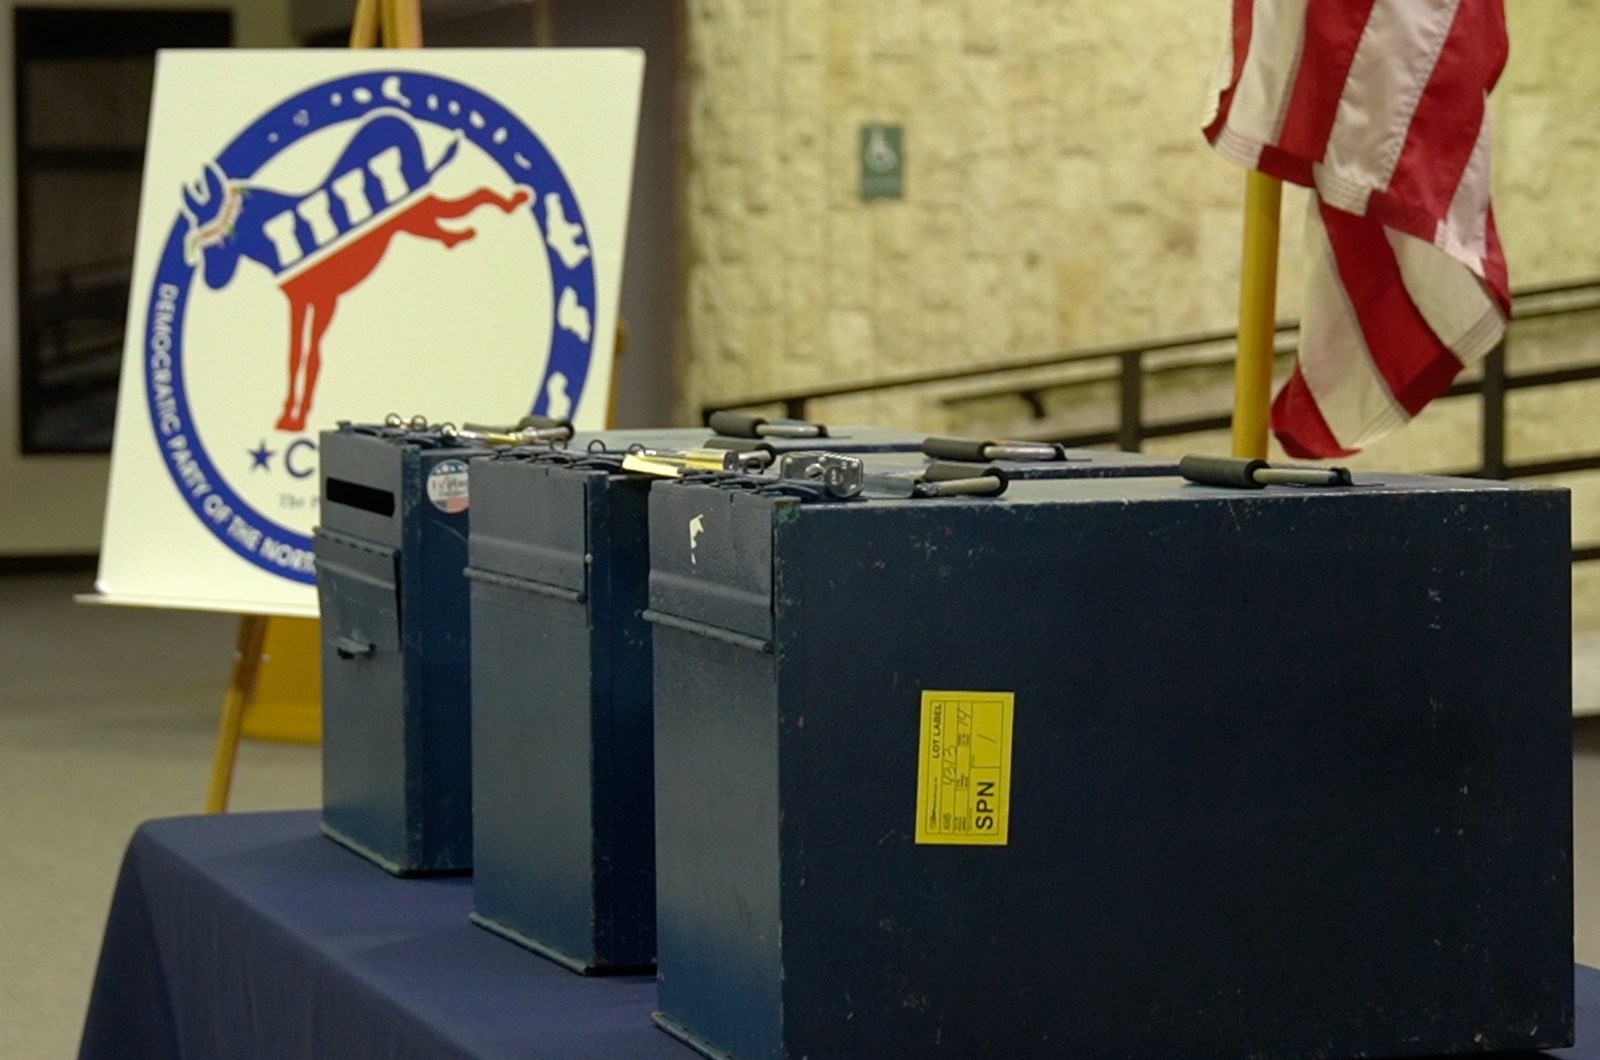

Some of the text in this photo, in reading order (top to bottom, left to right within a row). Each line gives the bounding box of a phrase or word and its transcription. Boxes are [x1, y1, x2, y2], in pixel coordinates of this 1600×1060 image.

[151, 283, 181, 436] DEMOCRATIC
[167, 434, 212, 498] PARTY
[203, 494, 234, 525] OF
[227, 514, 264, 552] THE
[932, 703, 942, 759] LOT LABEL
[975, 781, 995, 830] SPN
